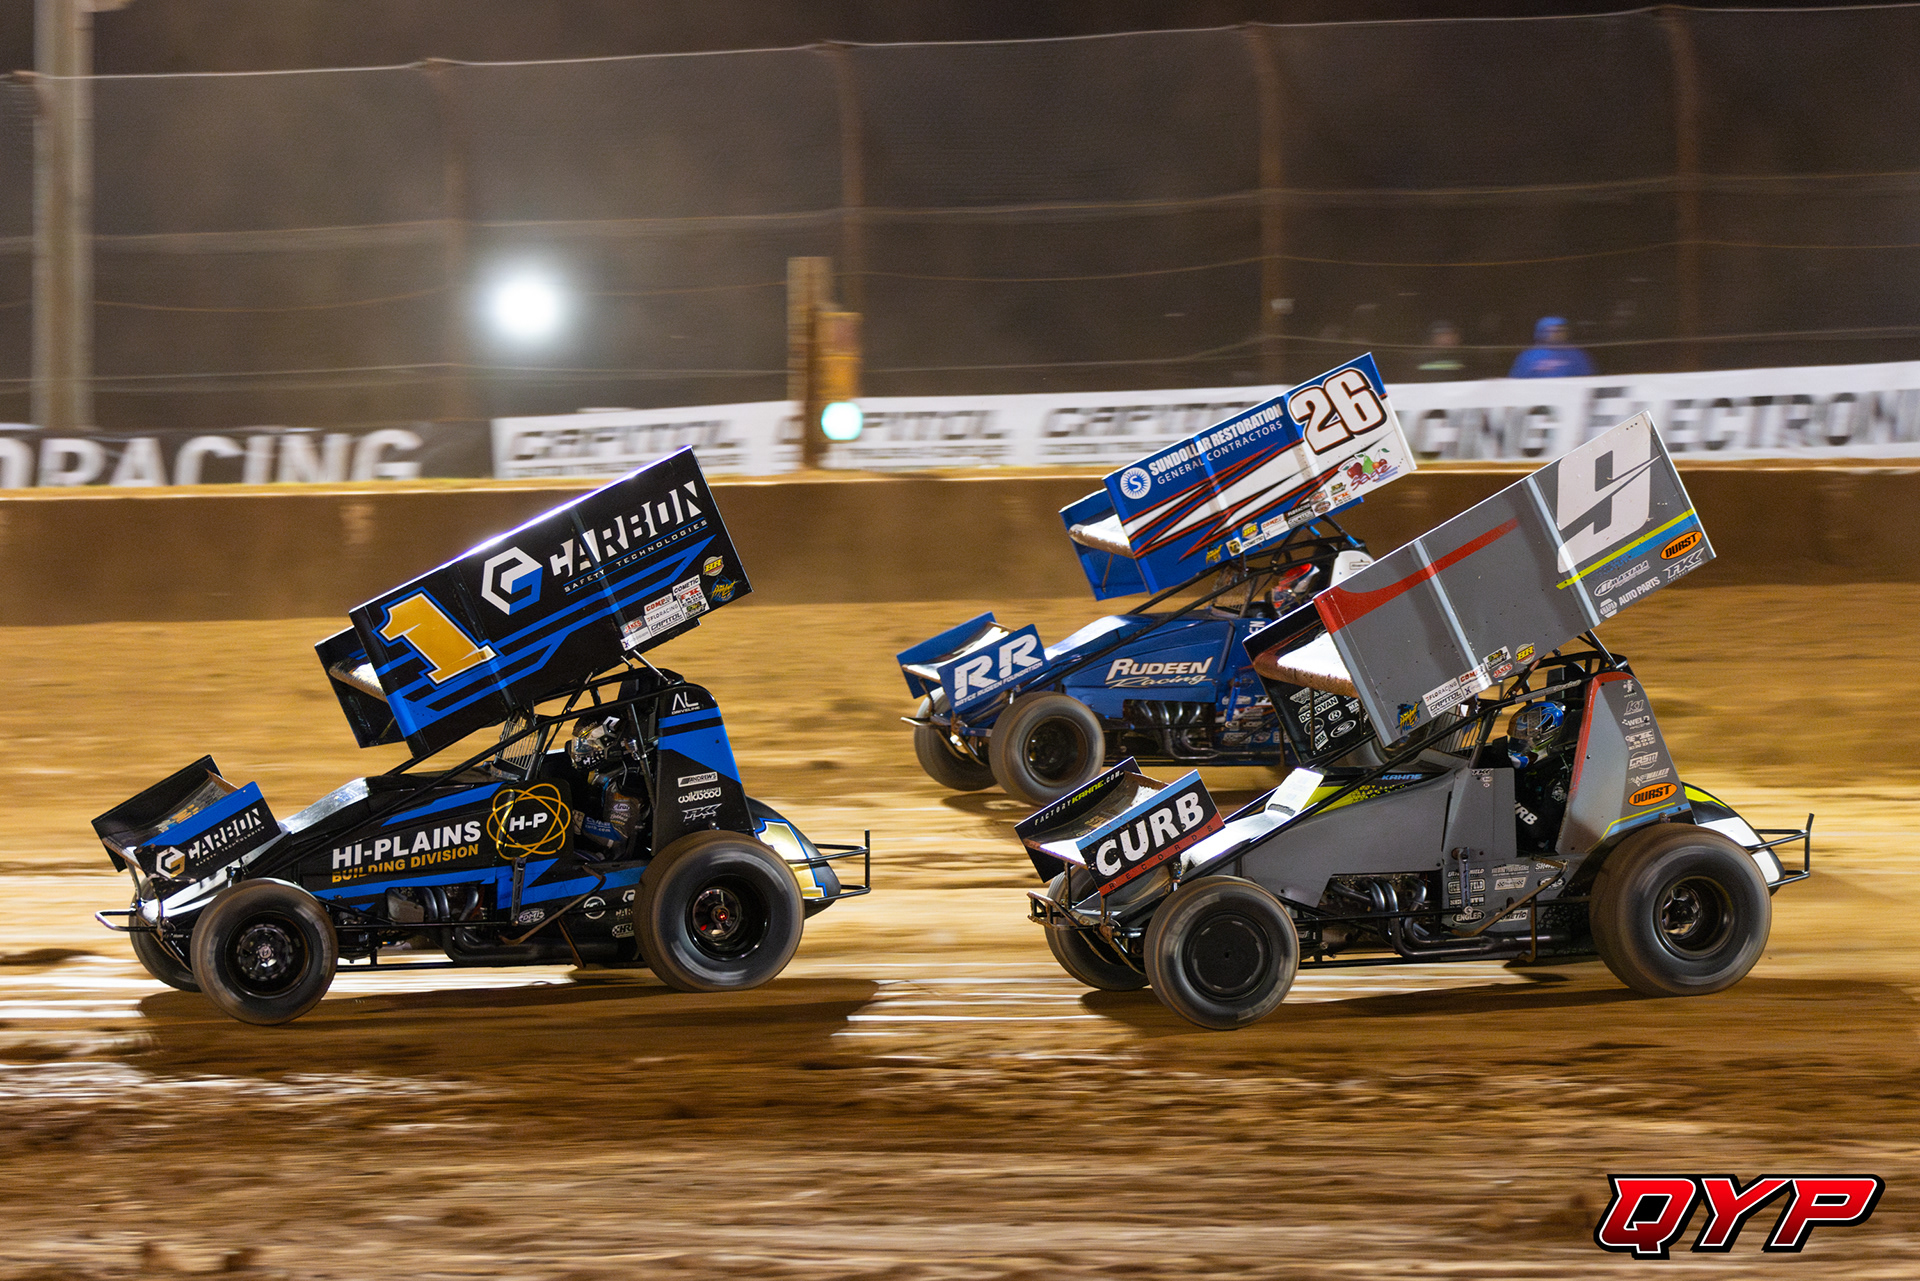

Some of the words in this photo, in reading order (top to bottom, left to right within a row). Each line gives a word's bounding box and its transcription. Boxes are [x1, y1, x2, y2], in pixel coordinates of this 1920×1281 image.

[1288, 368, 1388, 455] 26
[1148, 435, 1212, 477] SUNDOLLAR
[1210, 403, 1284, 446] RESTORATION
[1157, 458, 1205, 485] GENERAL
[1206, 420, 1283, 462] CONTRACTORS
[1557, 412, 1655, 574] 9
[564, 569, 606, 593] SAFETY
[616, 519, 708, 567] TECHNOLOGIES
[1665, 532, 1697, 558] DURST
[673, 577, 699, 594] COMETIC
[1618, 590, 1638, 606] AUTO
[1637, 577, 1660, 595] PARTS
[378, 591, 498, 686] 1
[1300, 697, 1338, 721] DOOVAN
[509, 812, 549, 832] H-P
[1633, 784, 1672, 804] DURST
[332, 820, 481, 869] HI-PLAINS
[1096, 792, 1204, 876] CURB
[1109, 826, 1214, 890] RECORDS
[332, 859, 406, 883] BUILDING
[411, 844, 479, 868] DIVISION
